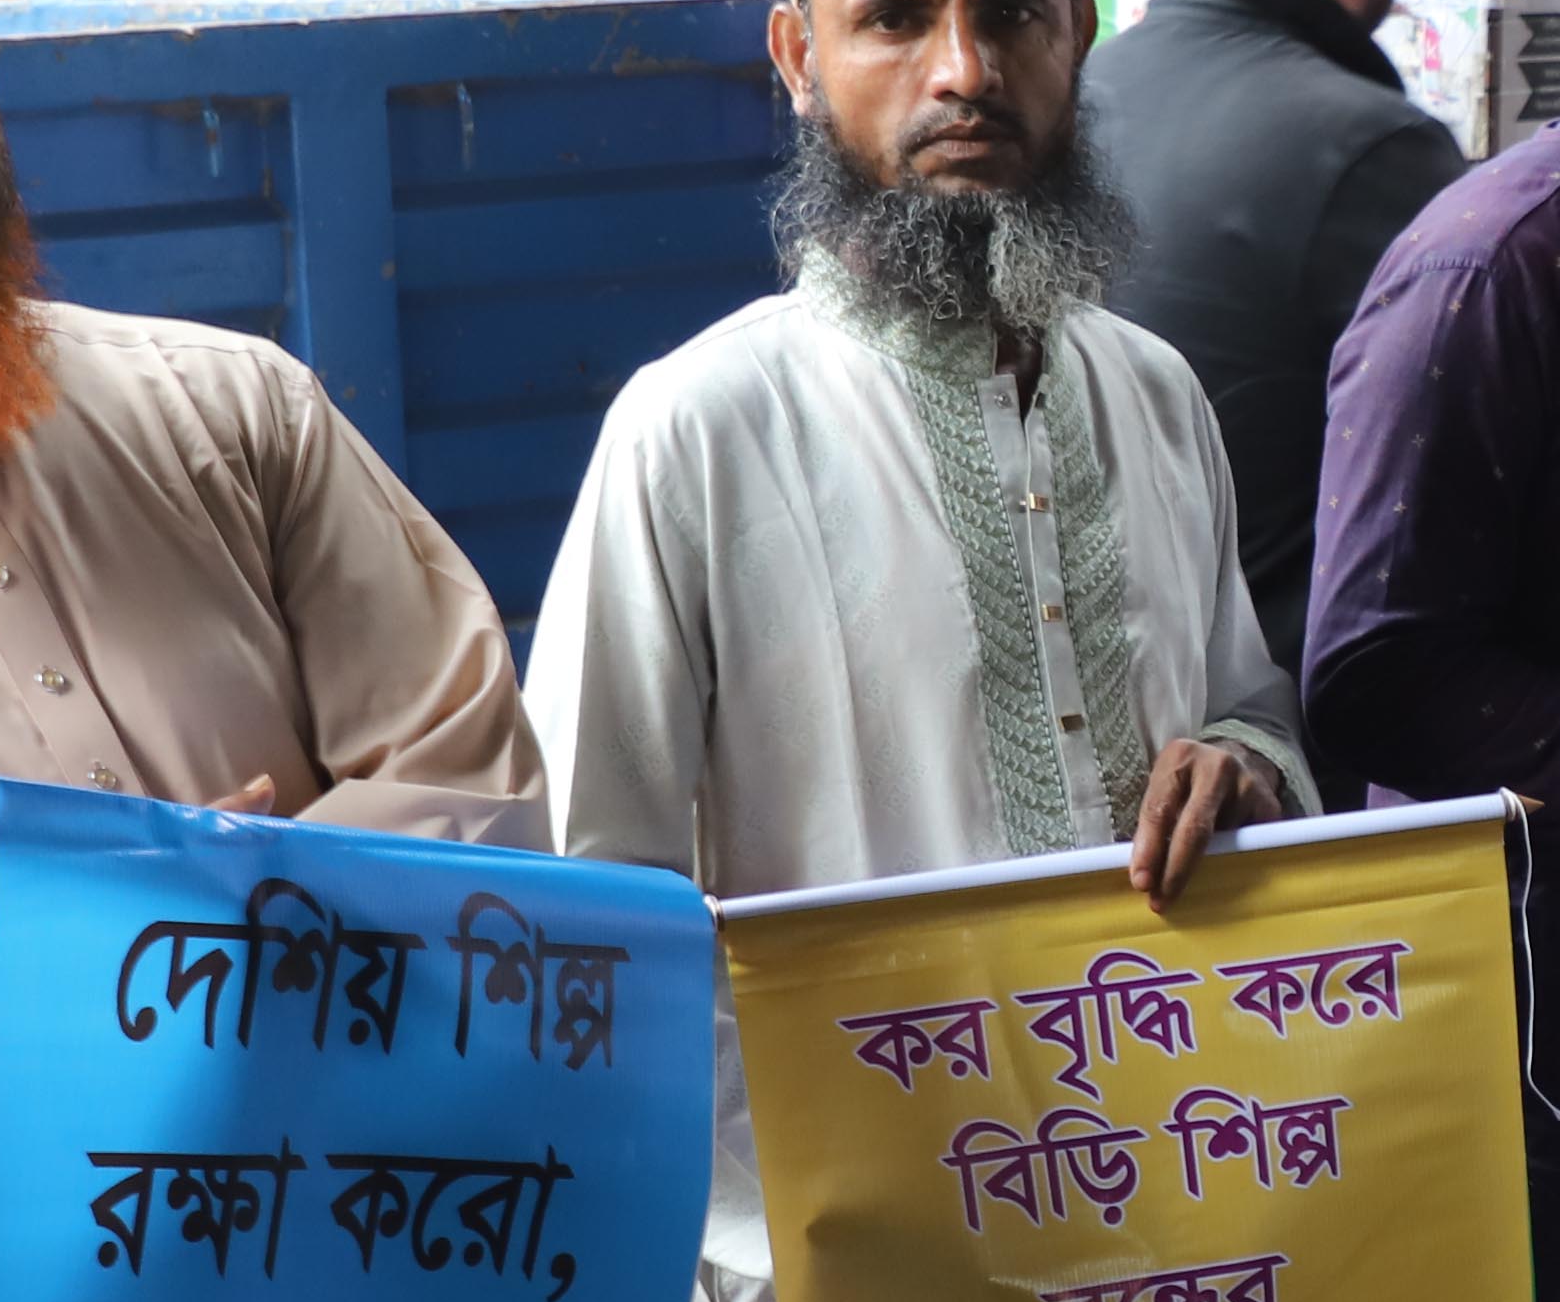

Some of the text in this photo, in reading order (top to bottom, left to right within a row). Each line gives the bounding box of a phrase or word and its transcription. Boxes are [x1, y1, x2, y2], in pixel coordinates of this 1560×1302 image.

[115, 878, 630, 1073] দেশিয় শিল্প
[838, 938, 1414, 1100] কর বৃদ্ধি করে
[87, 1135, 305, 1280] রক্ষা
[940, 1085, 1351, 1234] বিড়ি শিল্প
